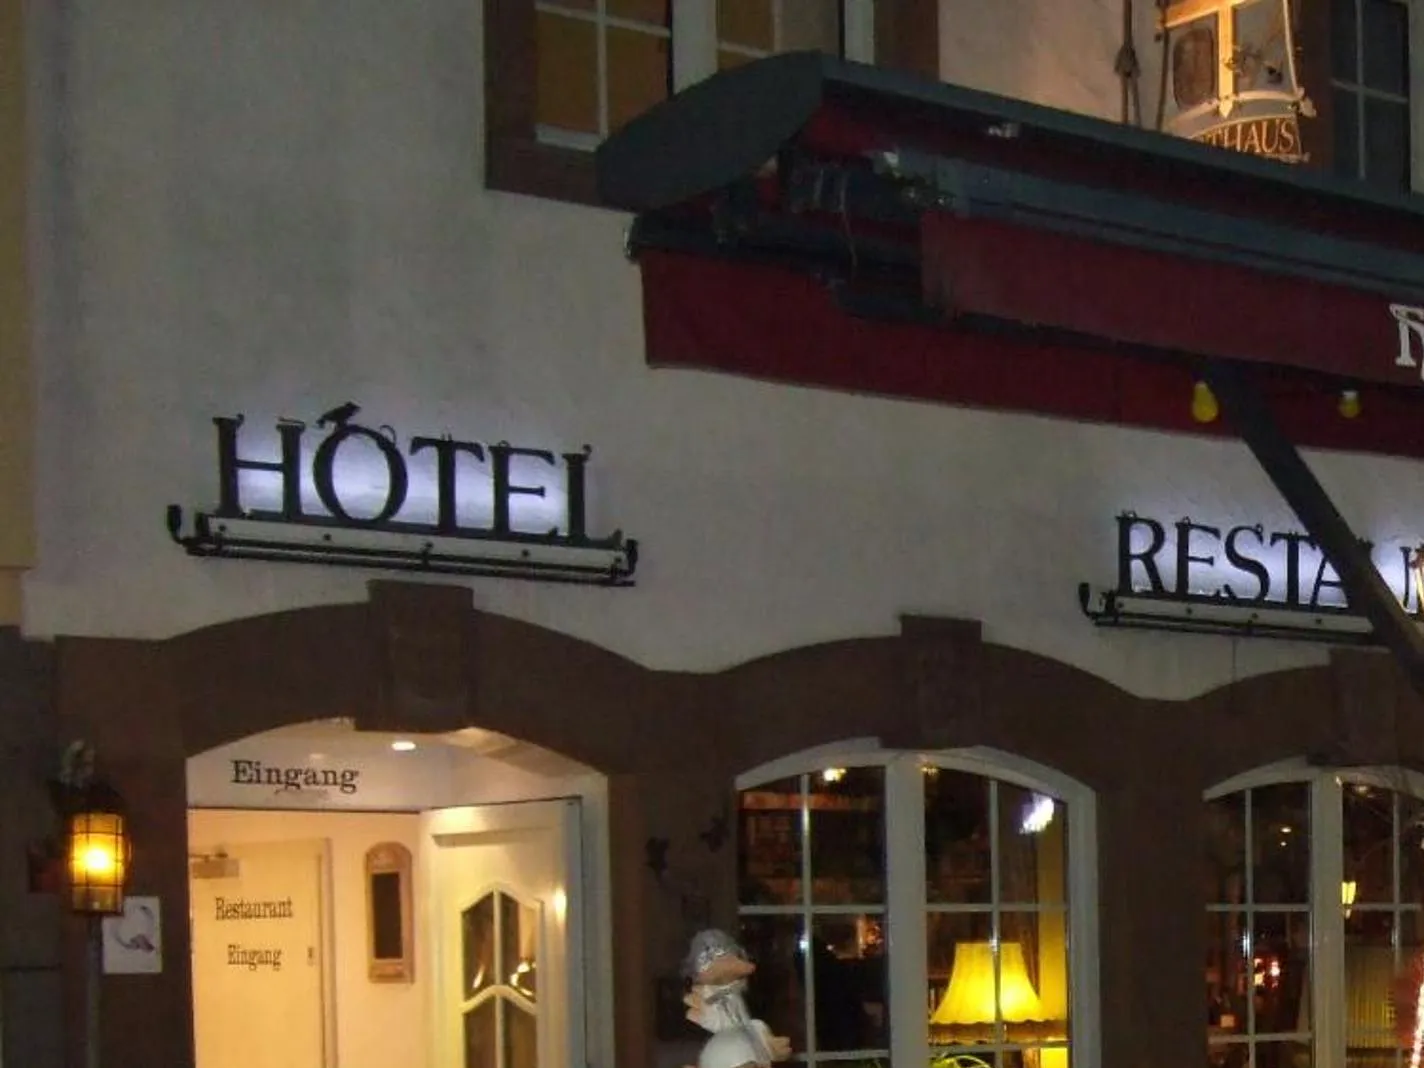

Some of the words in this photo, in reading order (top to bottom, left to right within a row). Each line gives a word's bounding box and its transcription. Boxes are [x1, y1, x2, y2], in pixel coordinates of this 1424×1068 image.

[229, 759, 359, 793] Eingang
[214, 896, 293, 921] Restaurant
[227, 944, 282, 971] Eingang
